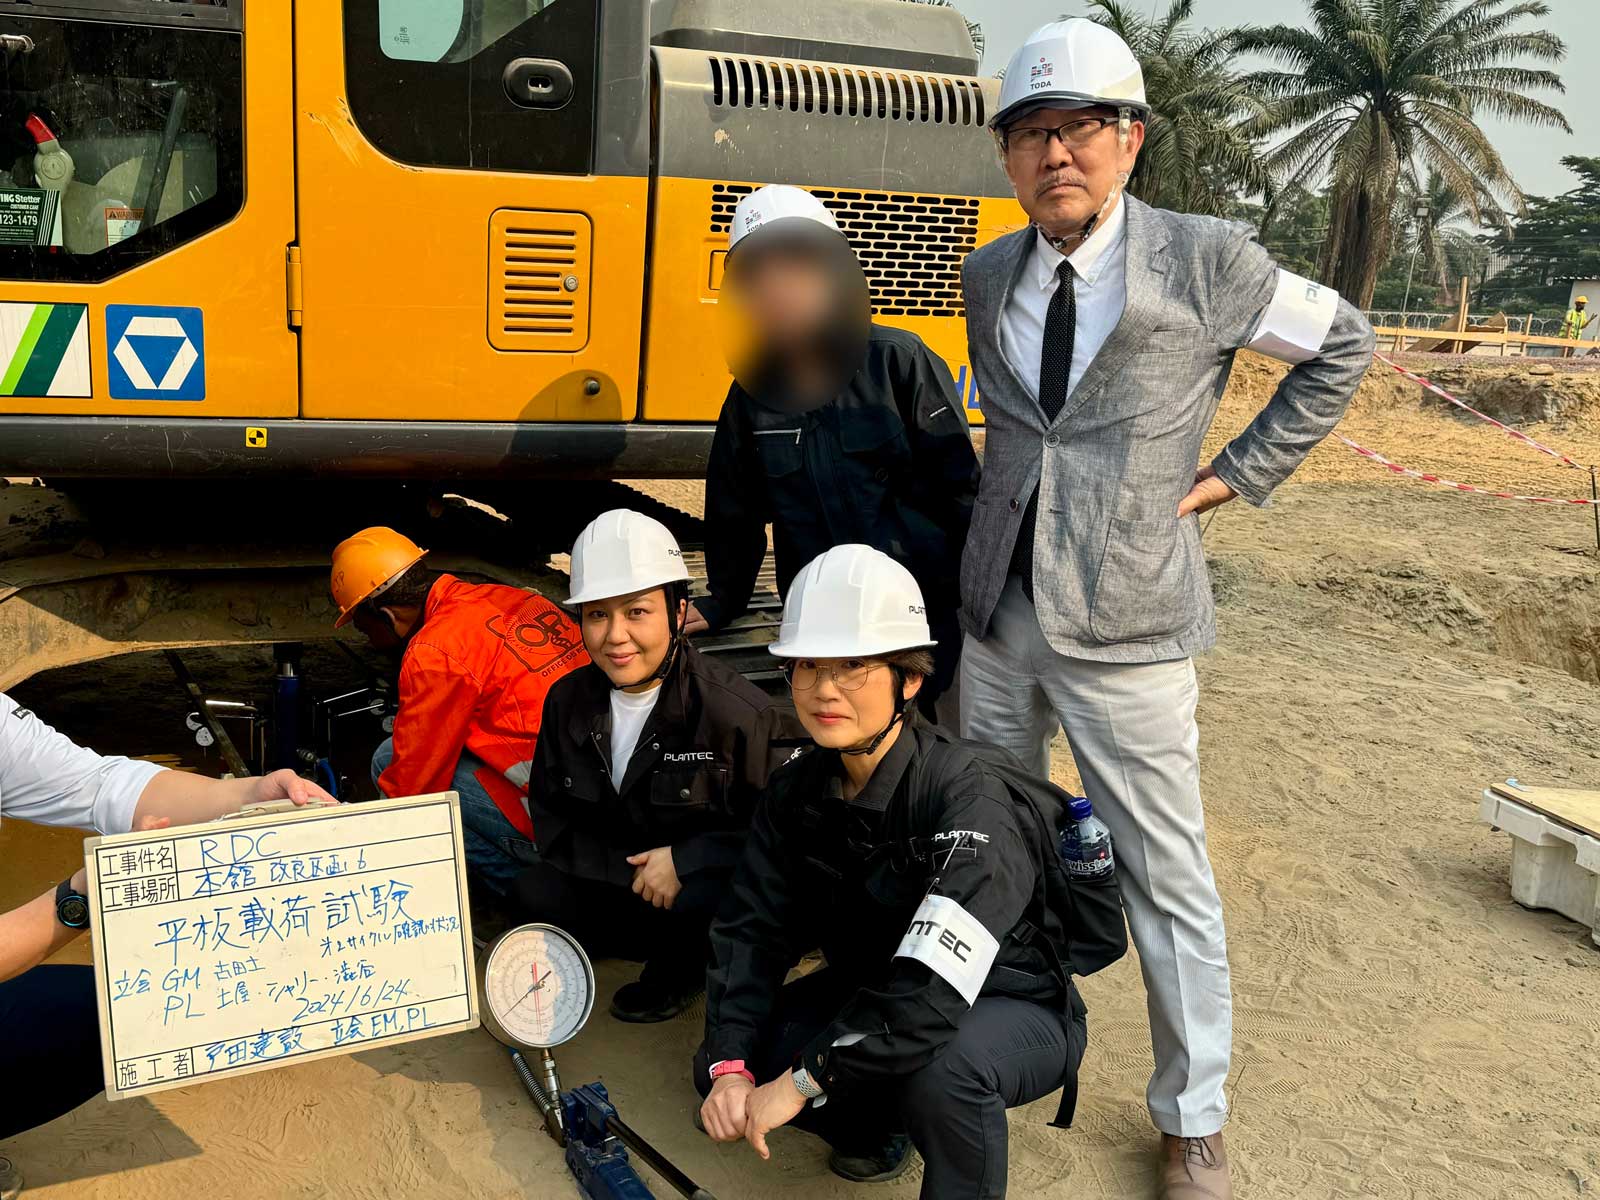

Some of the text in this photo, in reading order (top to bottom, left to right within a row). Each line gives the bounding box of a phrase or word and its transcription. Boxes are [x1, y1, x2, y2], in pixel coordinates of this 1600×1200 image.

[1030, 81, 1052, 90] TODA
[15, 194, 41, 204] Stetter
[541, 655, 568, 678] OFFICE
[663, 751, 714, 762] PLANTEC
[200, 831, 281, 868] RDC
[934, 830, 990, 843] PLANTEC
[102, 845, 174, 877] 工事件名
[104, 875, 177, 908] 工事場所
[154, 879, 414, 966] 平板載荷試験
[163, 993, 205, 1025] PL
[292, 978, 411, 1022] 2024/6/24
[119, 1052, 190, 1087] 施工者
